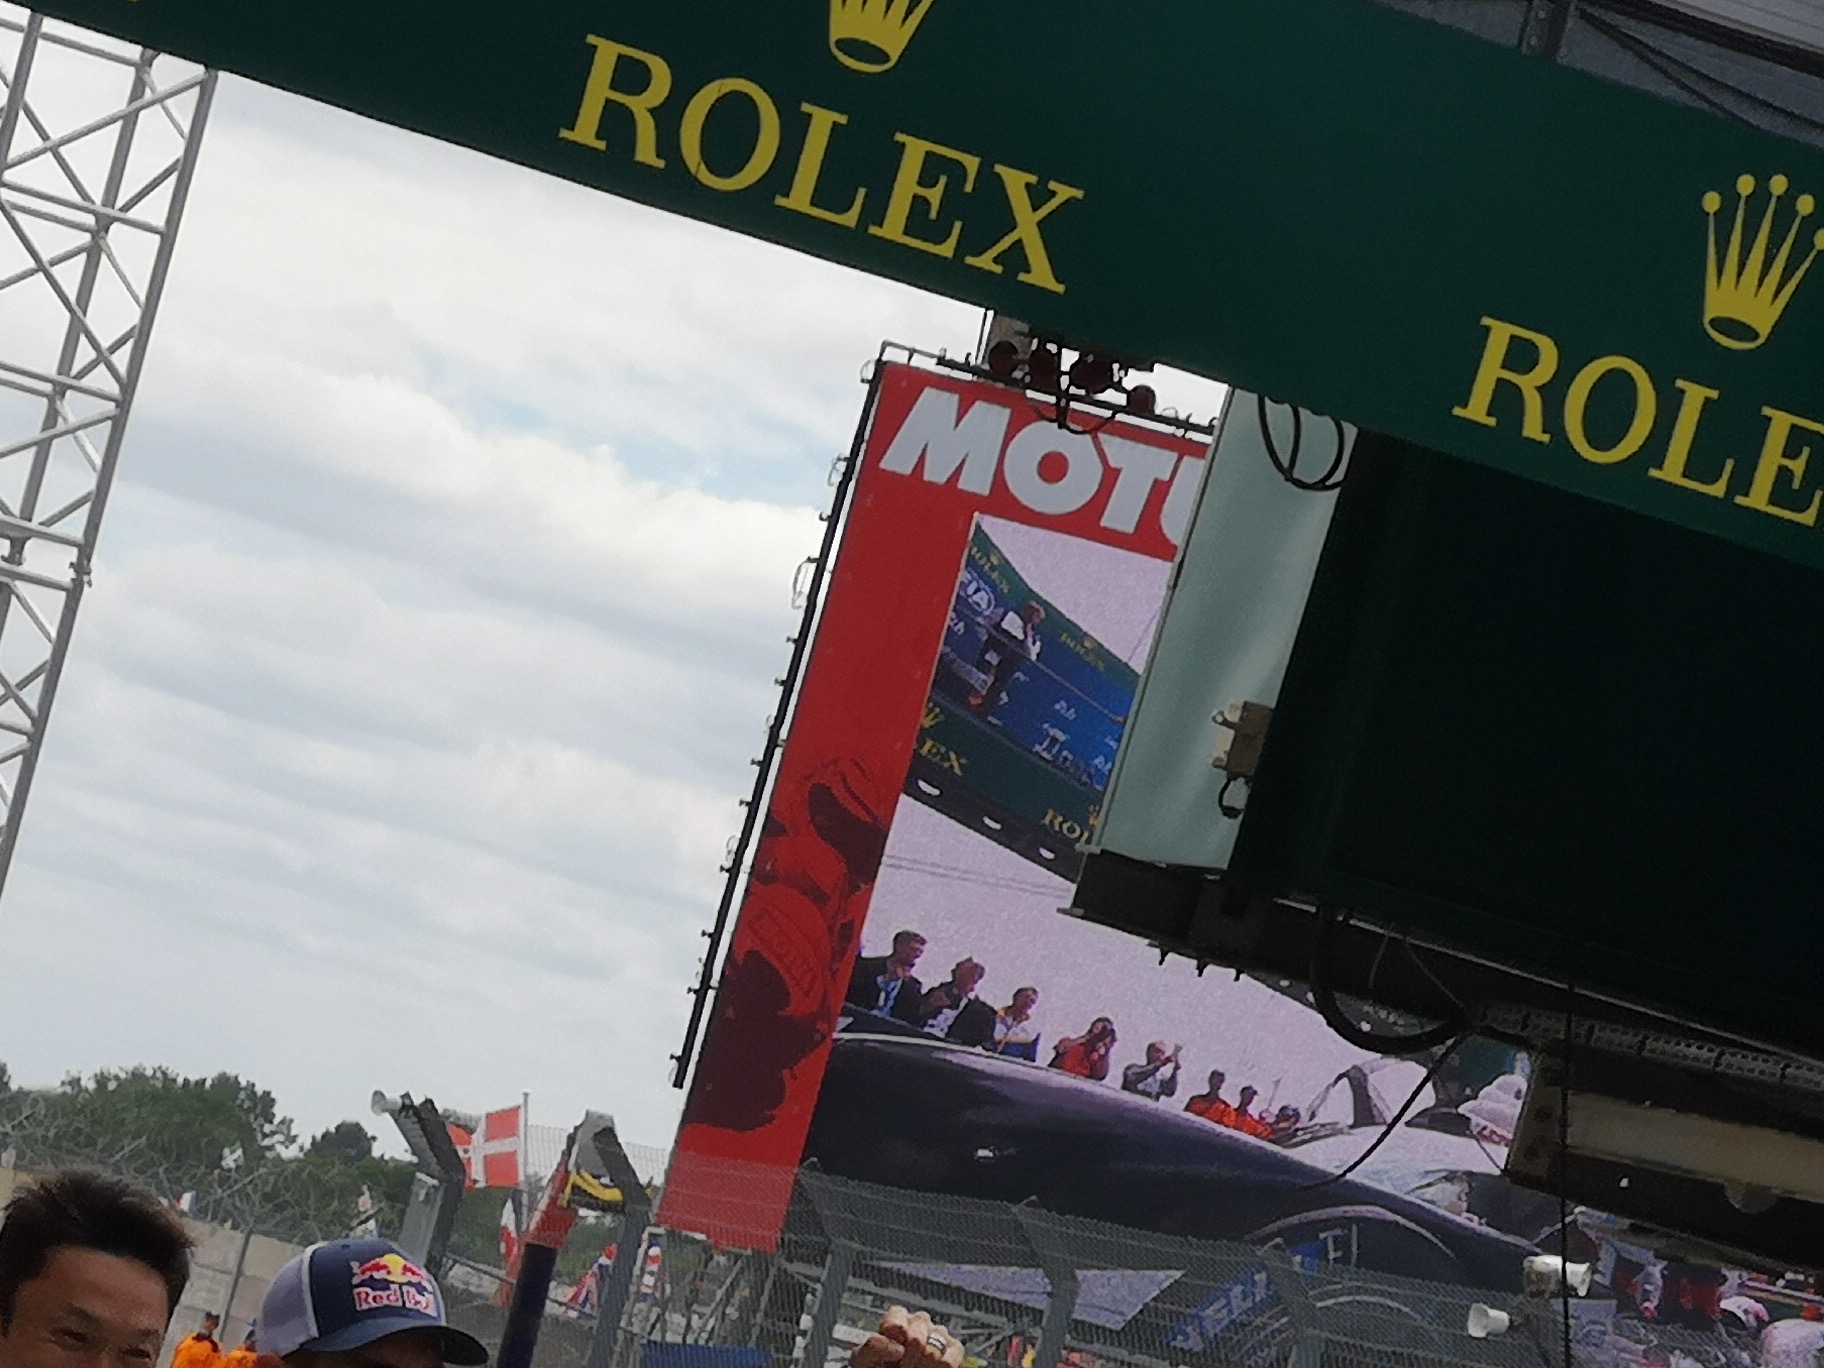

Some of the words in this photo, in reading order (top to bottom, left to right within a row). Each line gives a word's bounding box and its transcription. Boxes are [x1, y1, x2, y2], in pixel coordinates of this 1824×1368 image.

[558, 33, 1085, 294] ROLEX
[918, 739, 968, 776] EX
[356, 1286, 401, 1308] Red
